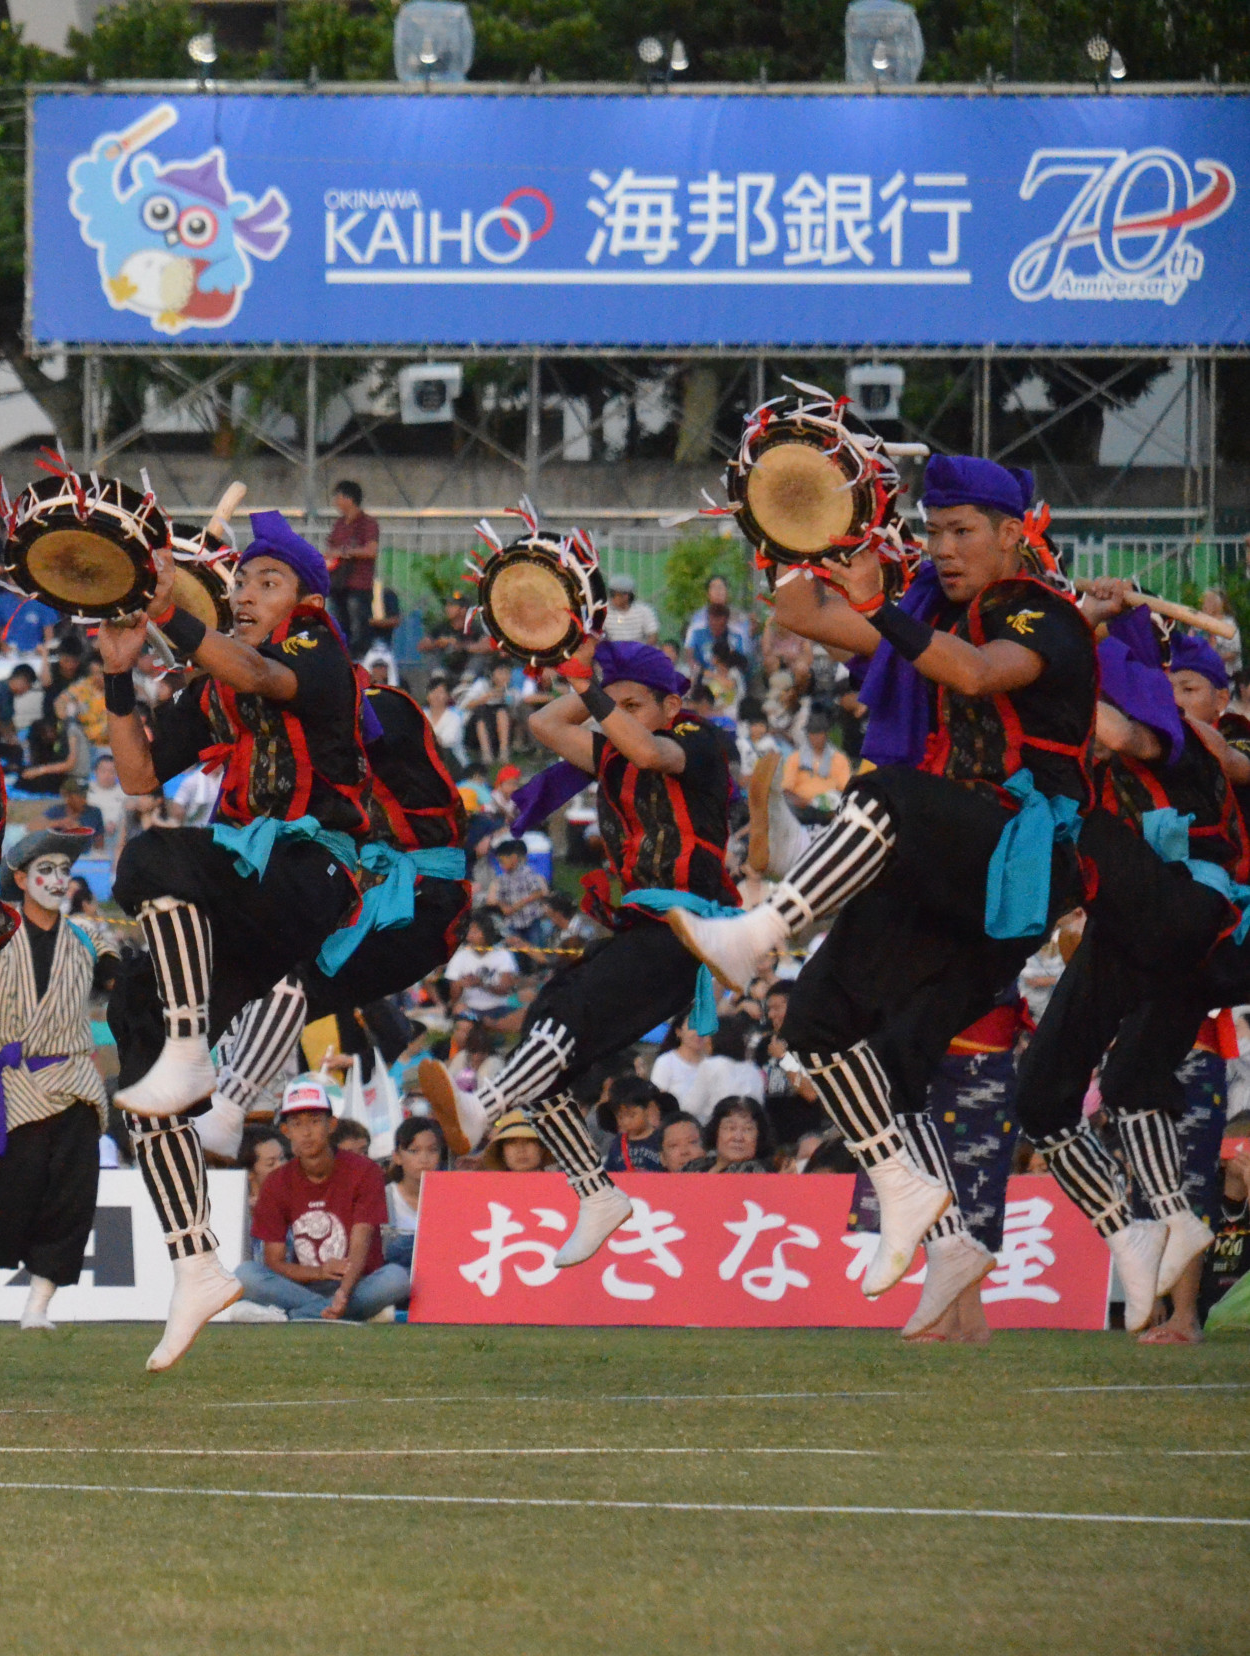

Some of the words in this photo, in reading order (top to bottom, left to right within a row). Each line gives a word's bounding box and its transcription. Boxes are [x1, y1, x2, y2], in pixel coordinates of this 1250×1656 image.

[324, 189, 421, 210] OKINAWA
[325, 206, 531, 265] KAIHO
[586, 168, 972, 266] 海邦銀行
[1052, 271, 1187, 304] Anniversary
